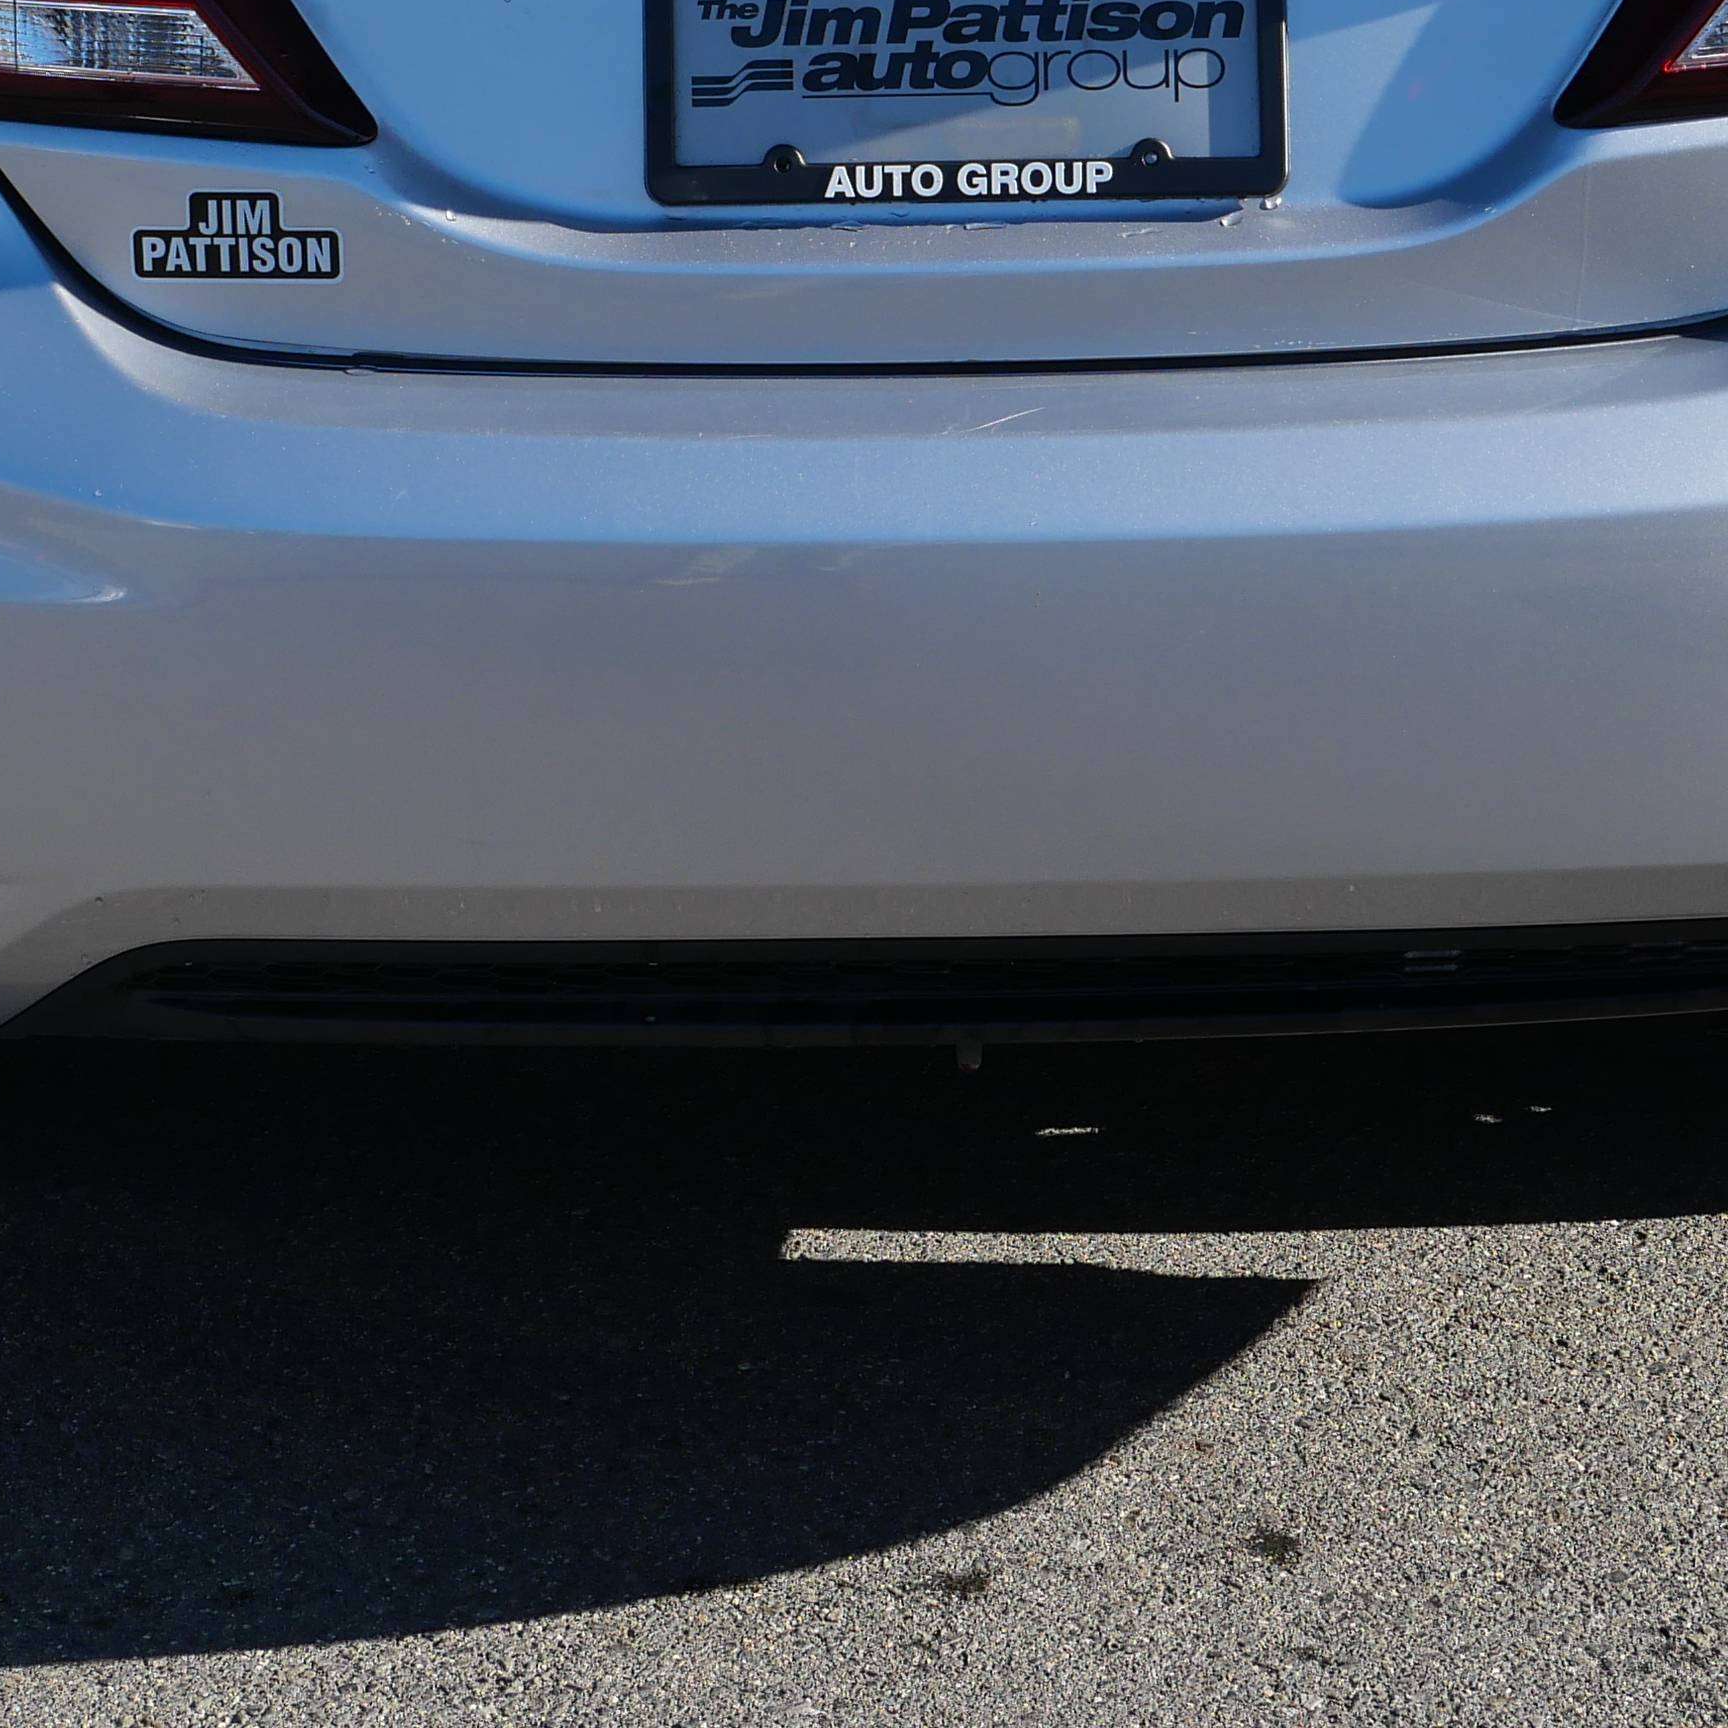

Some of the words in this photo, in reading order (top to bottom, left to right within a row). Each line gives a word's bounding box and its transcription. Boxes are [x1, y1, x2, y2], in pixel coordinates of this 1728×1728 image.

[824, 164, 945, 199] AUTO
[957, 160, 1114, 195] GROUP
[198, 199, 271, 236] JIM
[141, 236, 332, 273] PATTISON
